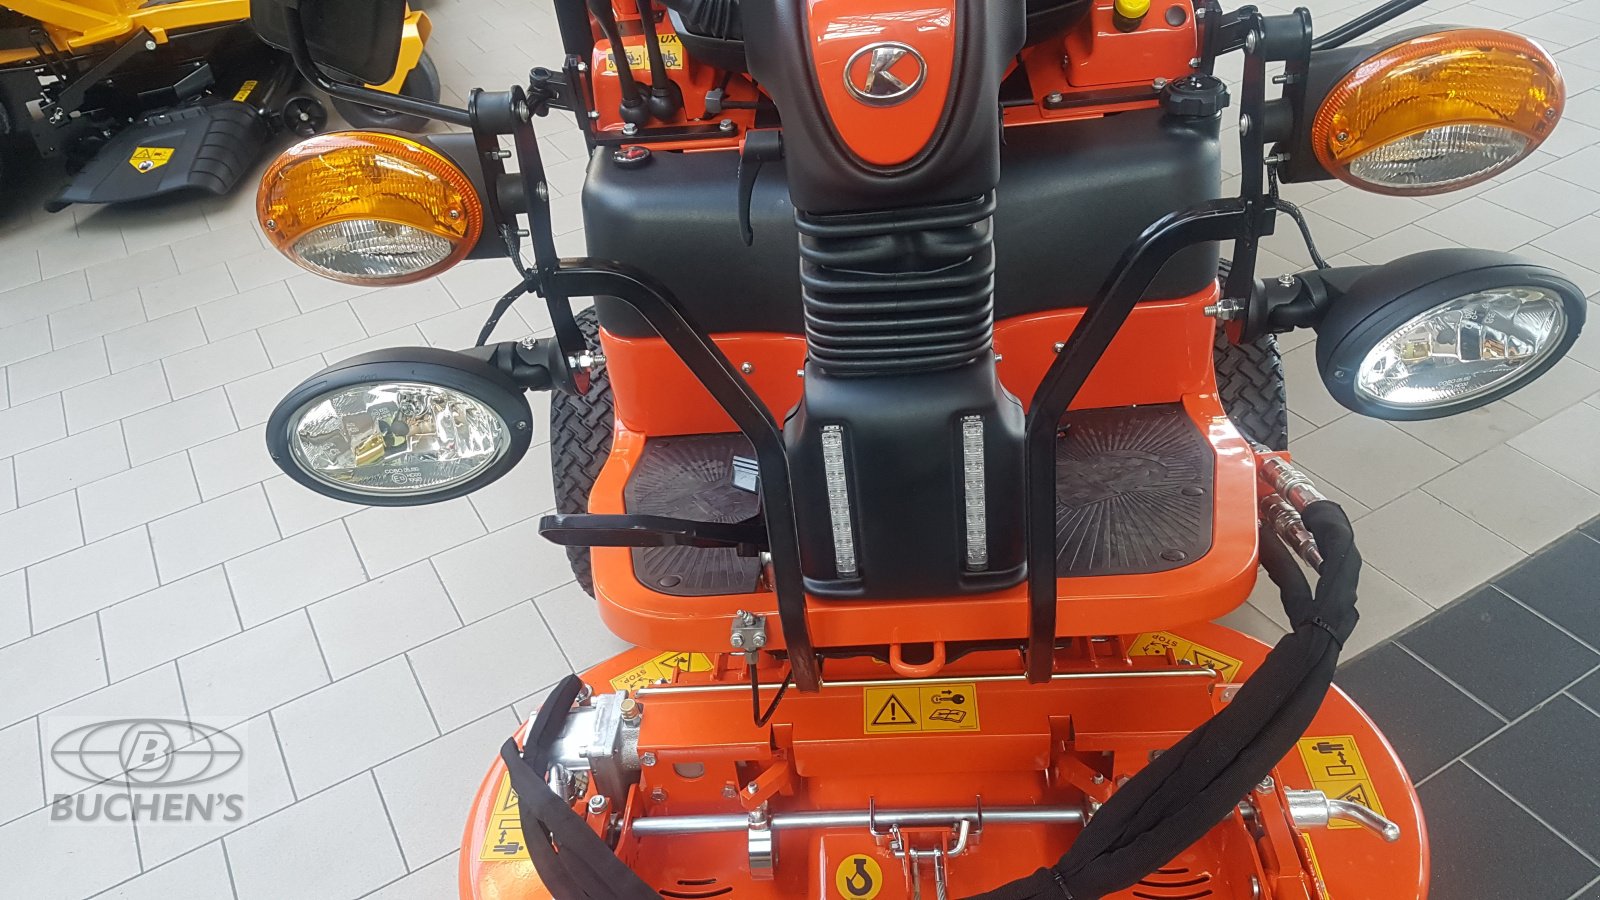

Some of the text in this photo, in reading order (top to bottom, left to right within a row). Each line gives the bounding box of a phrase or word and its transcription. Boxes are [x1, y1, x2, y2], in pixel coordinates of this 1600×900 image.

[660, 34, 677, 44] UX
[863, 47, 908, 97] K
[1151, 634, 1178, 647] STOP
